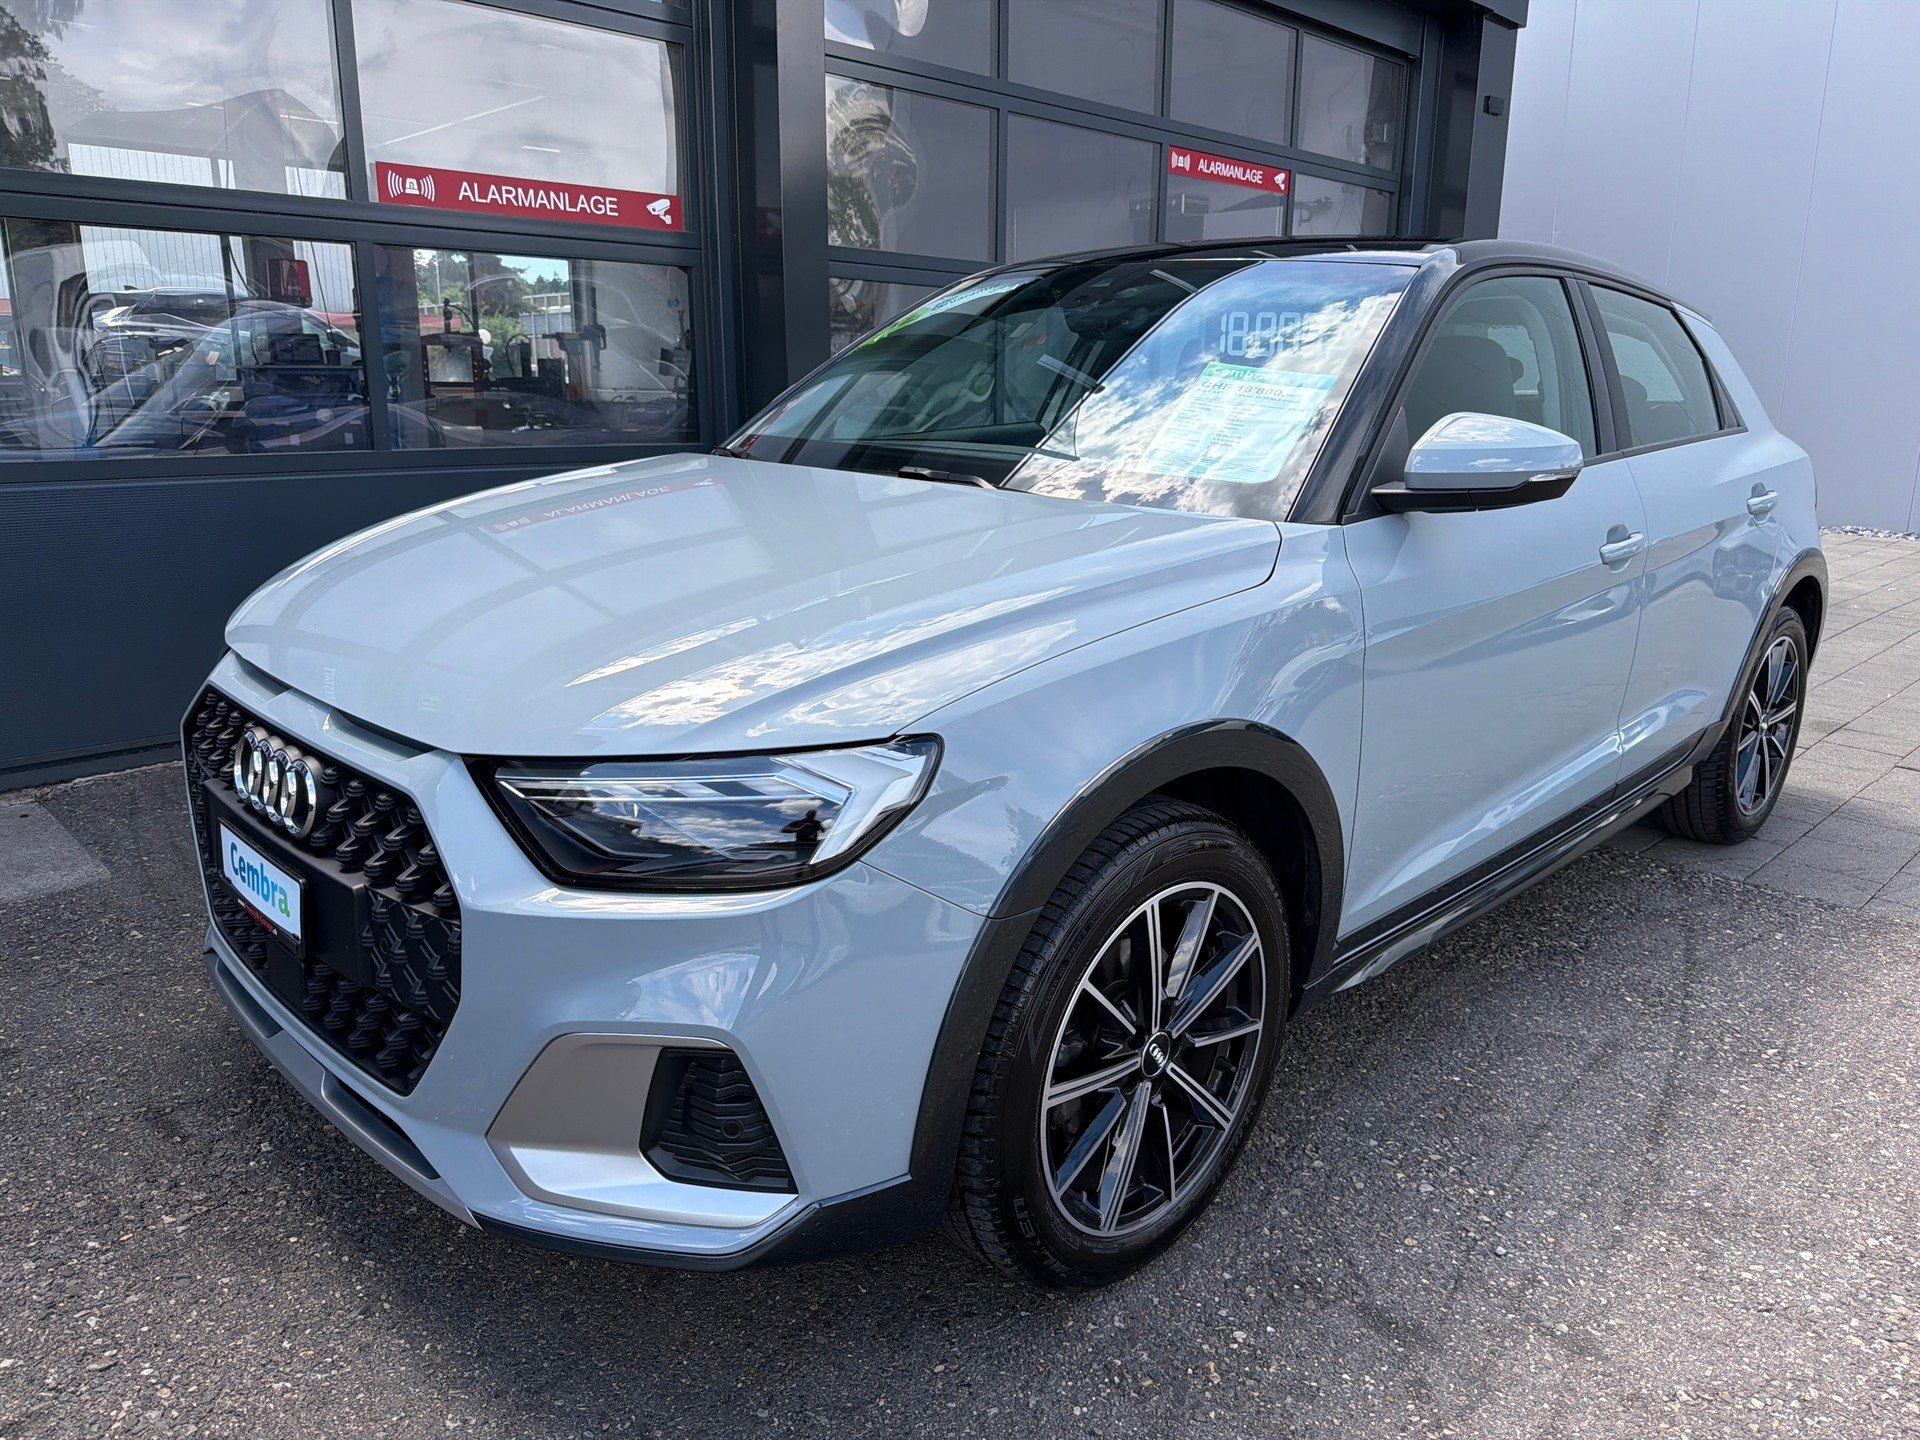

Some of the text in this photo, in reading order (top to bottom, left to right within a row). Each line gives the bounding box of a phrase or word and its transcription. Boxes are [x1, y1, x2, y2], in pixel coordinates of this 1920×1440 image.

[1198, 158, 1264, 184] ALARMANLAGE
[458, 180, 620, 217] ALARMANLAGE
[230, 841, 290, 918] Cembra
